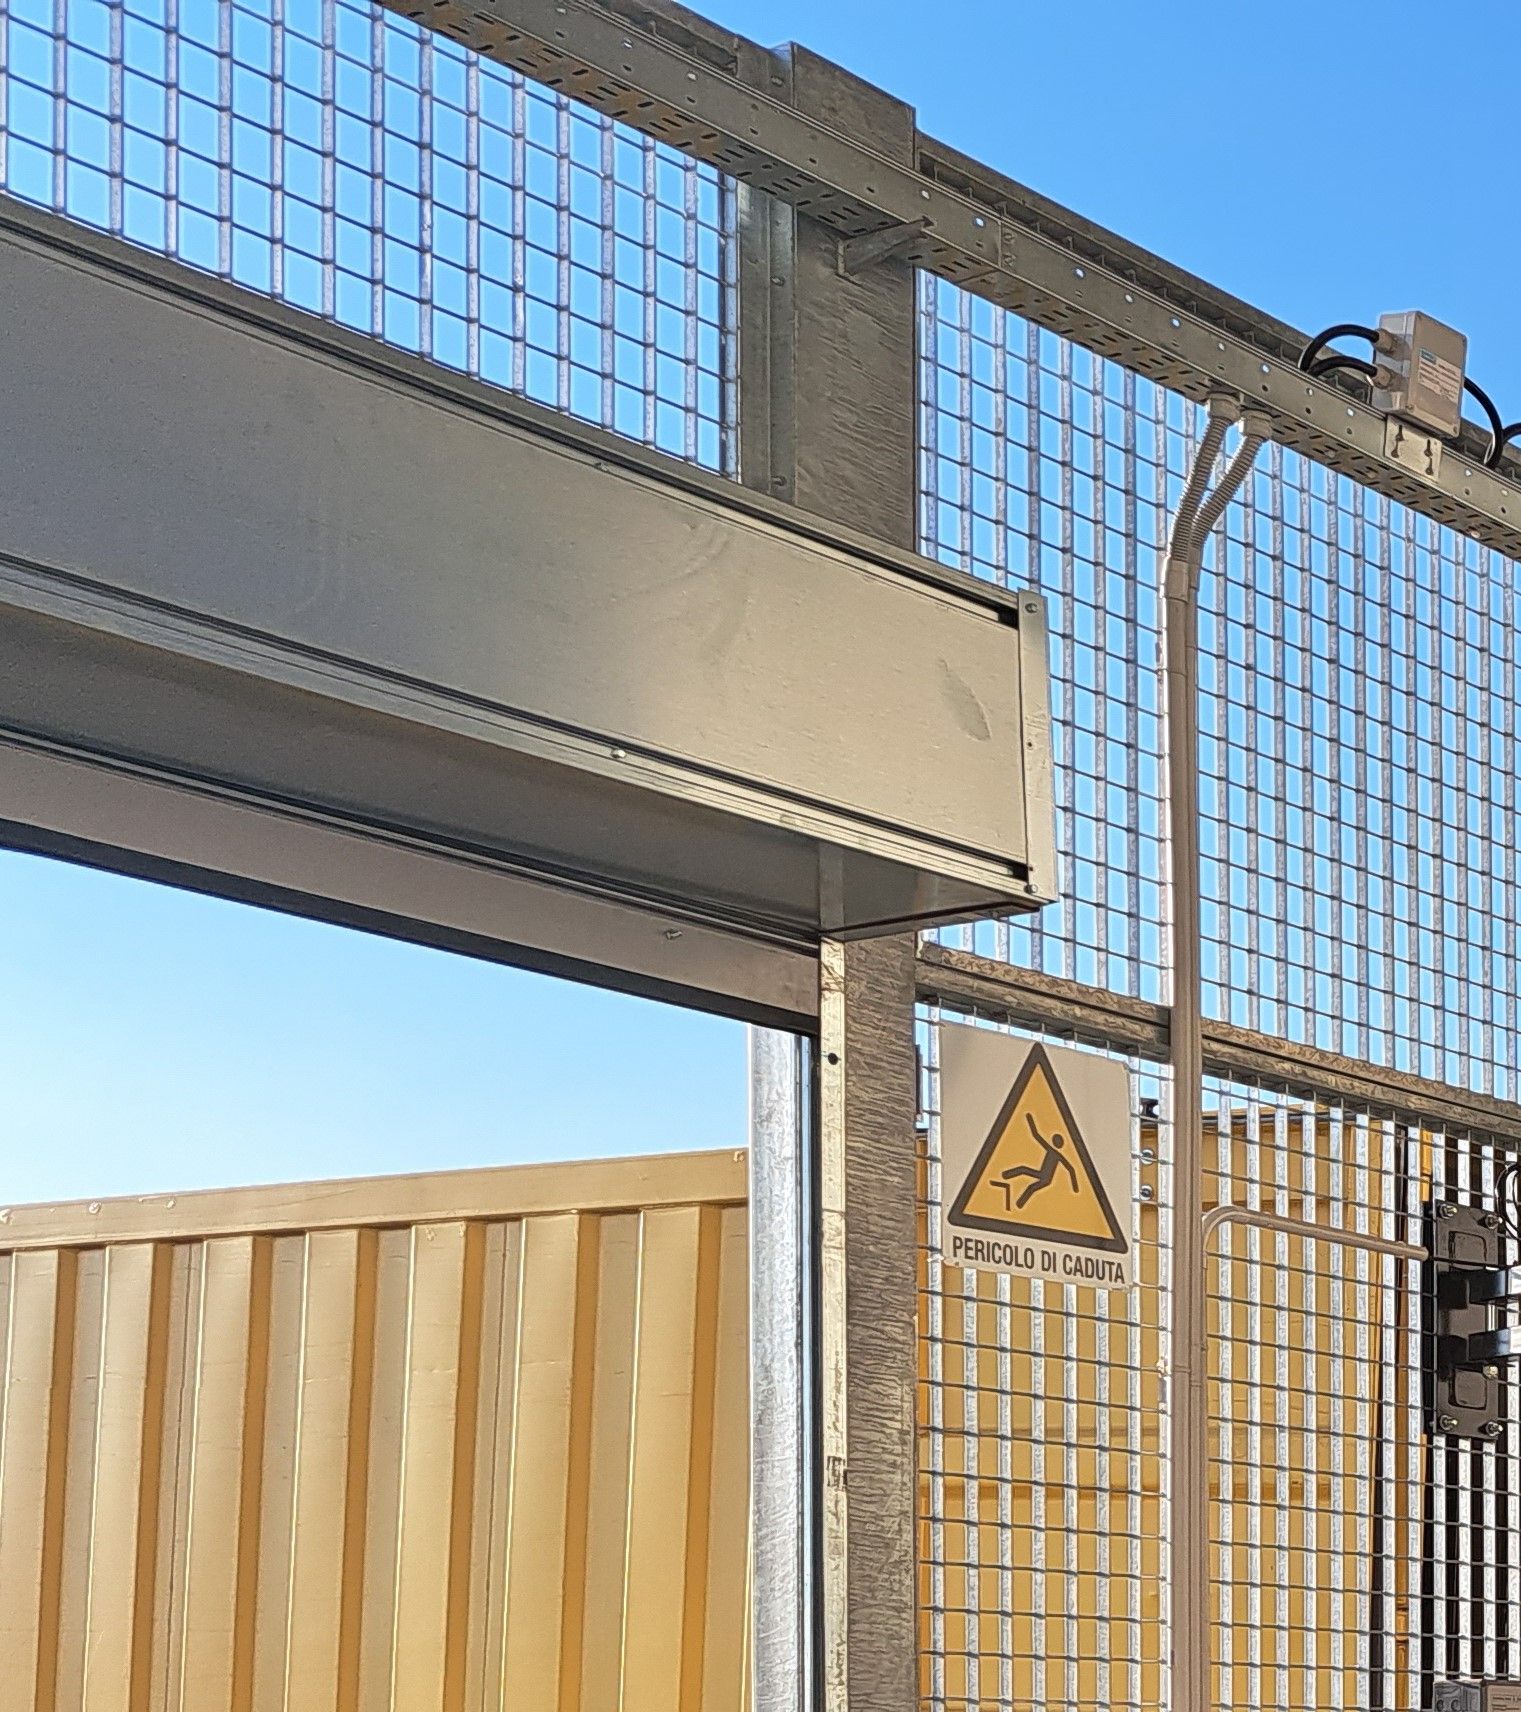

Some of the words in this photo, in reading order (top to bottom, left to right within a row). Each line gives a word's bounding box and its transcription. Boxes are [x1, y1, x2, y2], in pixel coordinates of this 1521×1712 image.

[953, 1235, 1035, 1270] PERICOLO
[1041, 1249, 1057, 1273] DI
[1063, 1253, 1126, 1285] CADUTA
